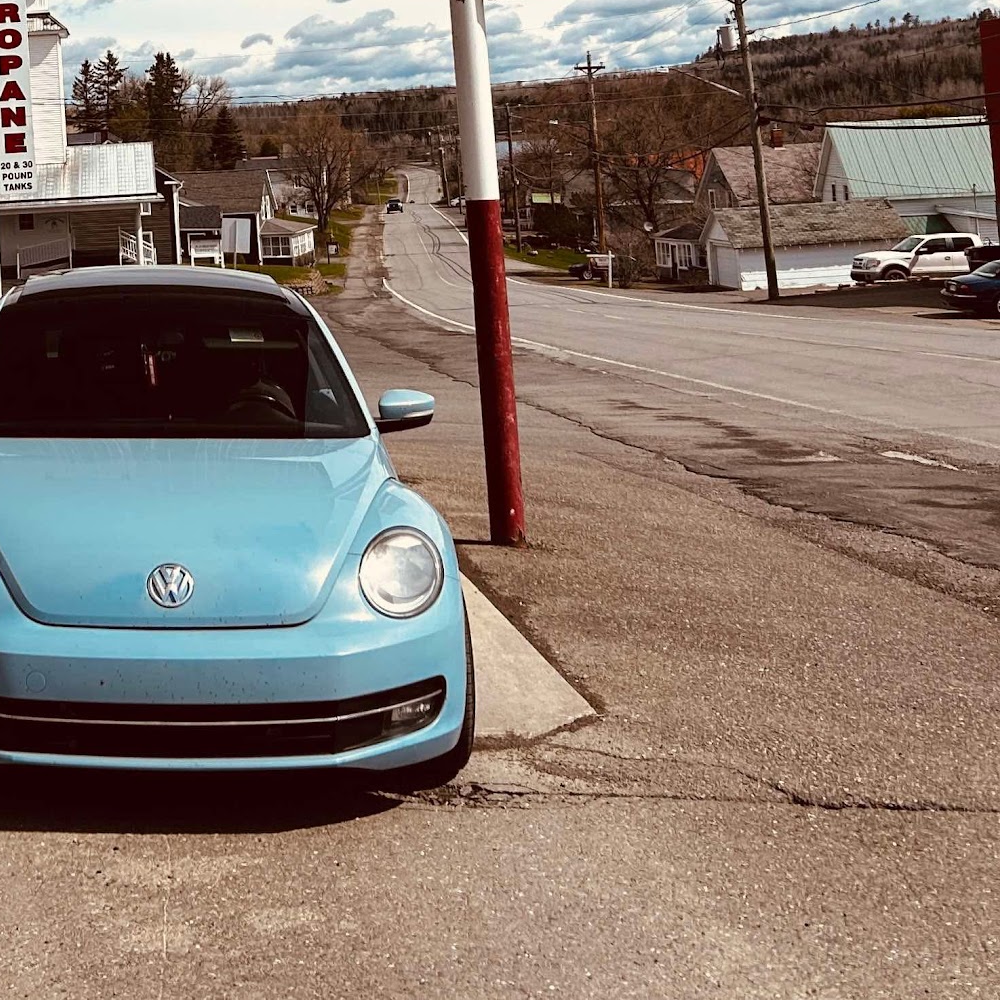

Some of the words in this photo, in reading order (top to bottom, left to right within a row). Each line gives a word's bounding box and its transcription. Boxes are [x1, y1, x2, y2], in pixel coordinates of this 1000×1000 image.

[1, 161, 12, 170] 20
[13, 161, 21, 169] &
[22, 160, 33, 169] 30
[2, 171, 33, 181] POUND
[3, 181, 33, 192] TANKS
